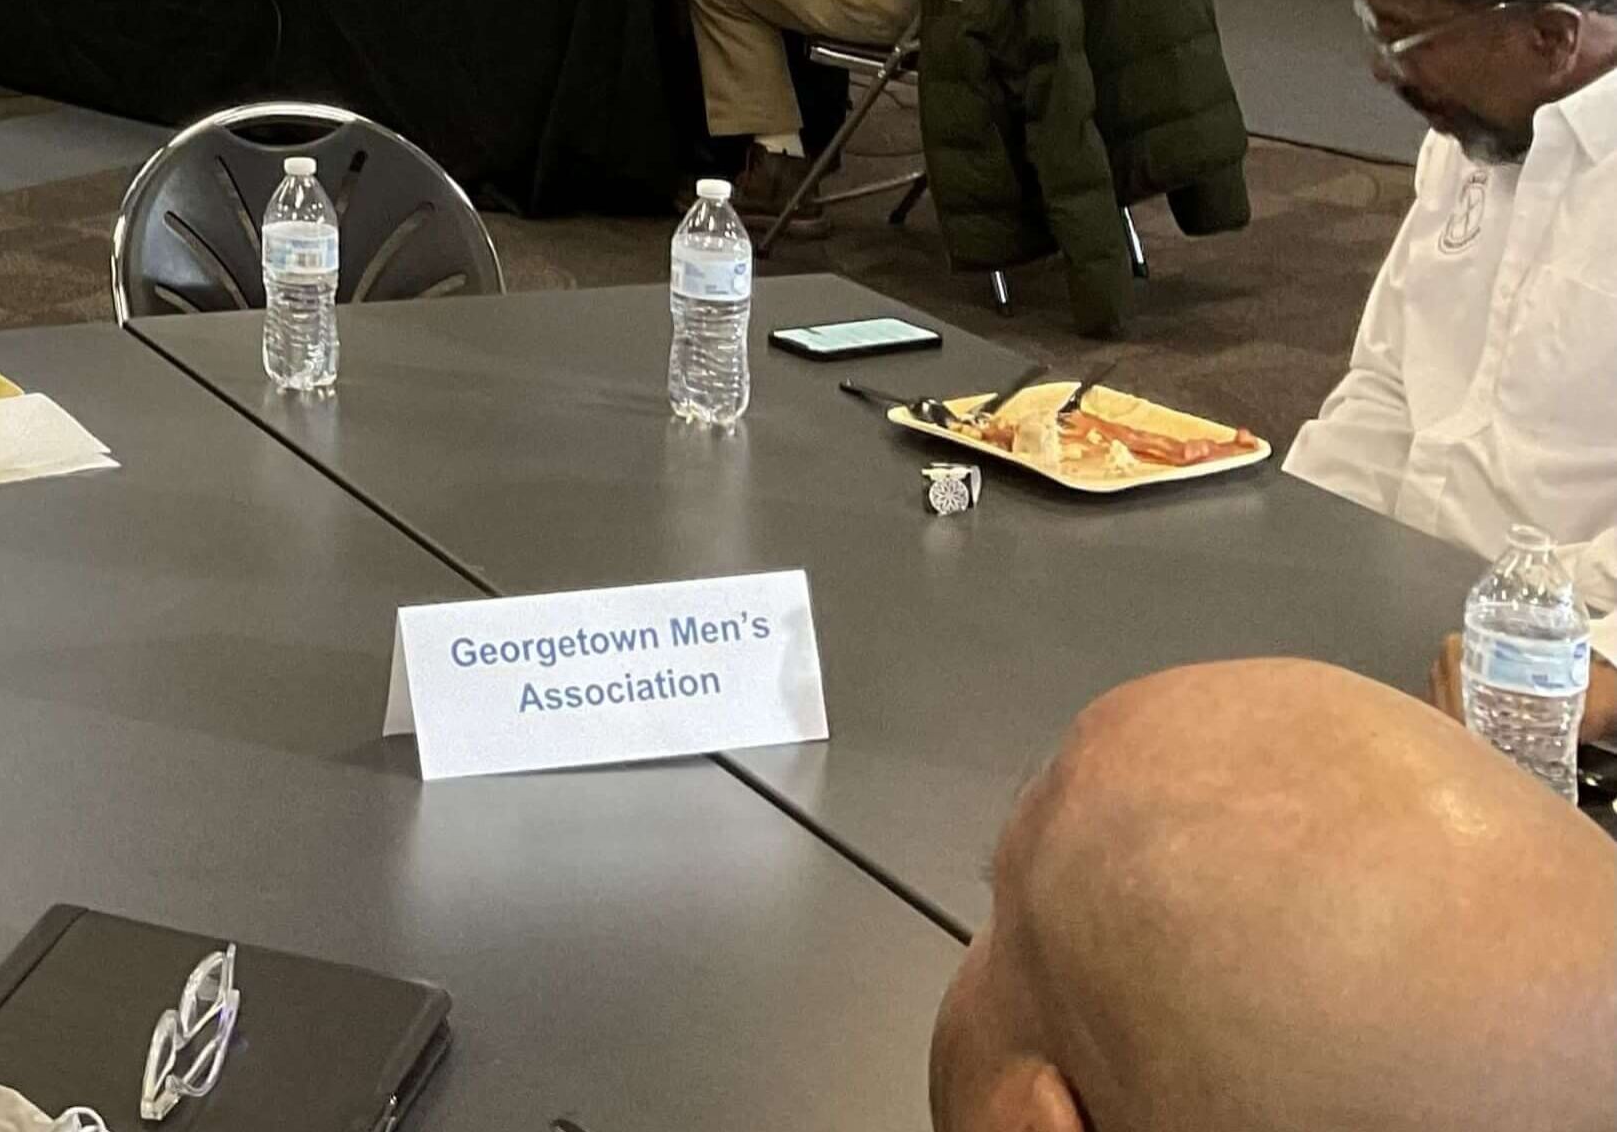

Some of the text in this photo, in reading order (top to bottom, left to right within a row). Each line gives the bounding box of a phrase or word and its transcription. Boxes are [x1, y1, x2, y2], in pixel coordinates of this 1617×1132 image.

[450, 611, 771, 668] Georgetown Men’s
[518, 668, 722, 713] Association
